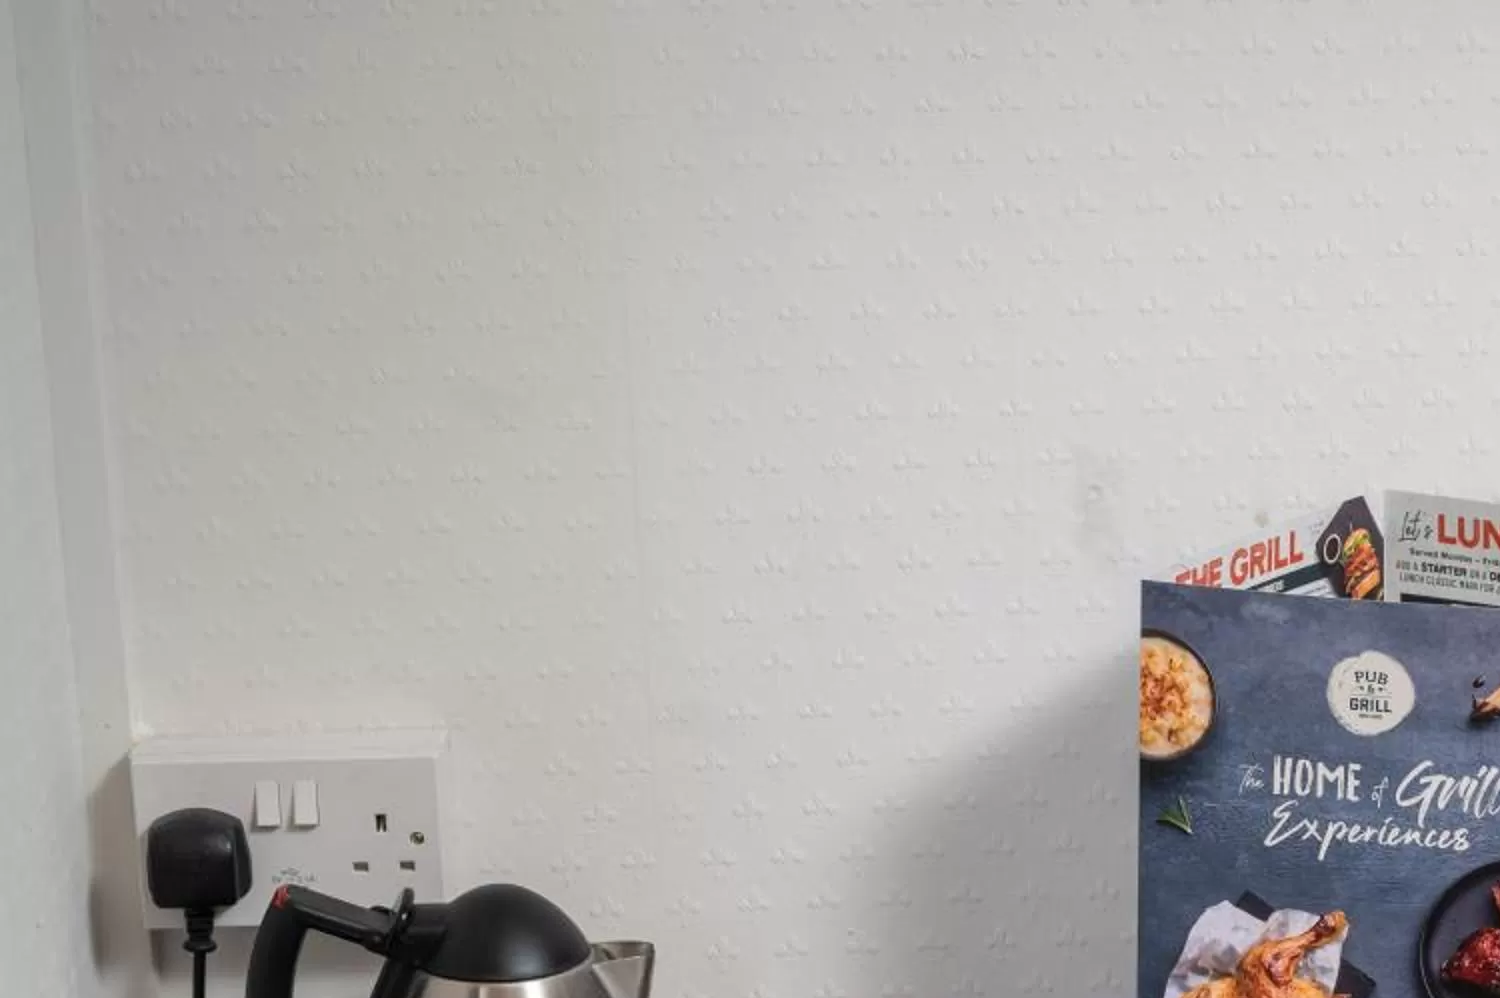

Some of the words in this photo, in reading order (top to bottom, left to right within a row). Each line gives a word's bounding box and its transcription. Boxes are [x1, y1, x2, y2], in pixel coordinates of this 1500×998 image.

[1229, 529, 1304, 586] GRILL
[1421, 560, 1467, 578] STARTER
[1354, 671, 1389, 685] PUB
[1349, 697, 1392, 713] GRILL
[1238, 764, 1265, 796] The
[1272, 754, 1362, 803] HOME
[1371, 776, 1389, 809] of
[1263, 799, 1471, 862] Experiences
